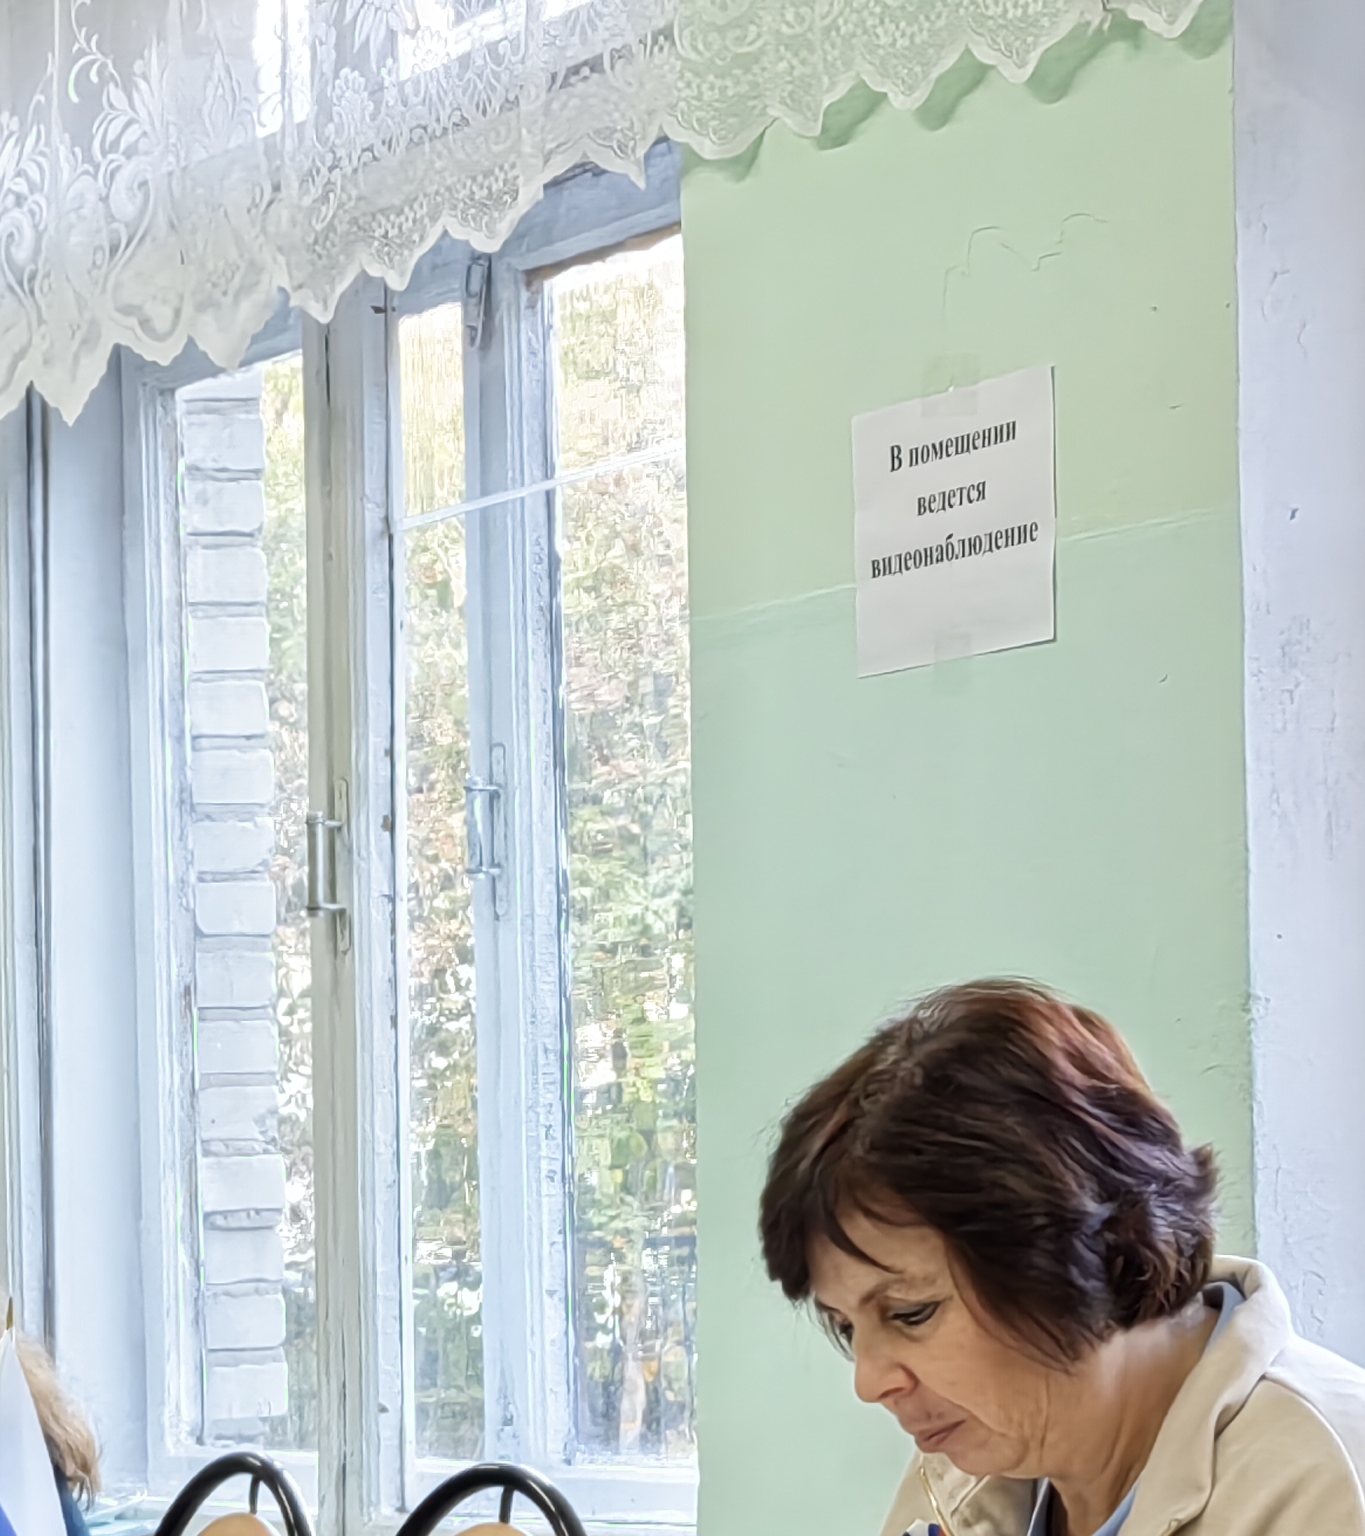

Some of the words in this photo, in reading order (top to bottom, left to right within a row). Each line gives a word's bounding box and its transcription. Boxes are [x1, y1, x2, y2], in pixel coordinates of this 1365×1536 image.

[889, 444, 903, 473] В
[908, 420, 1017, 468] помещении
[916, 480, 987, 517] ведется
[870, 520, 1039, 579] видеонаблюдение
